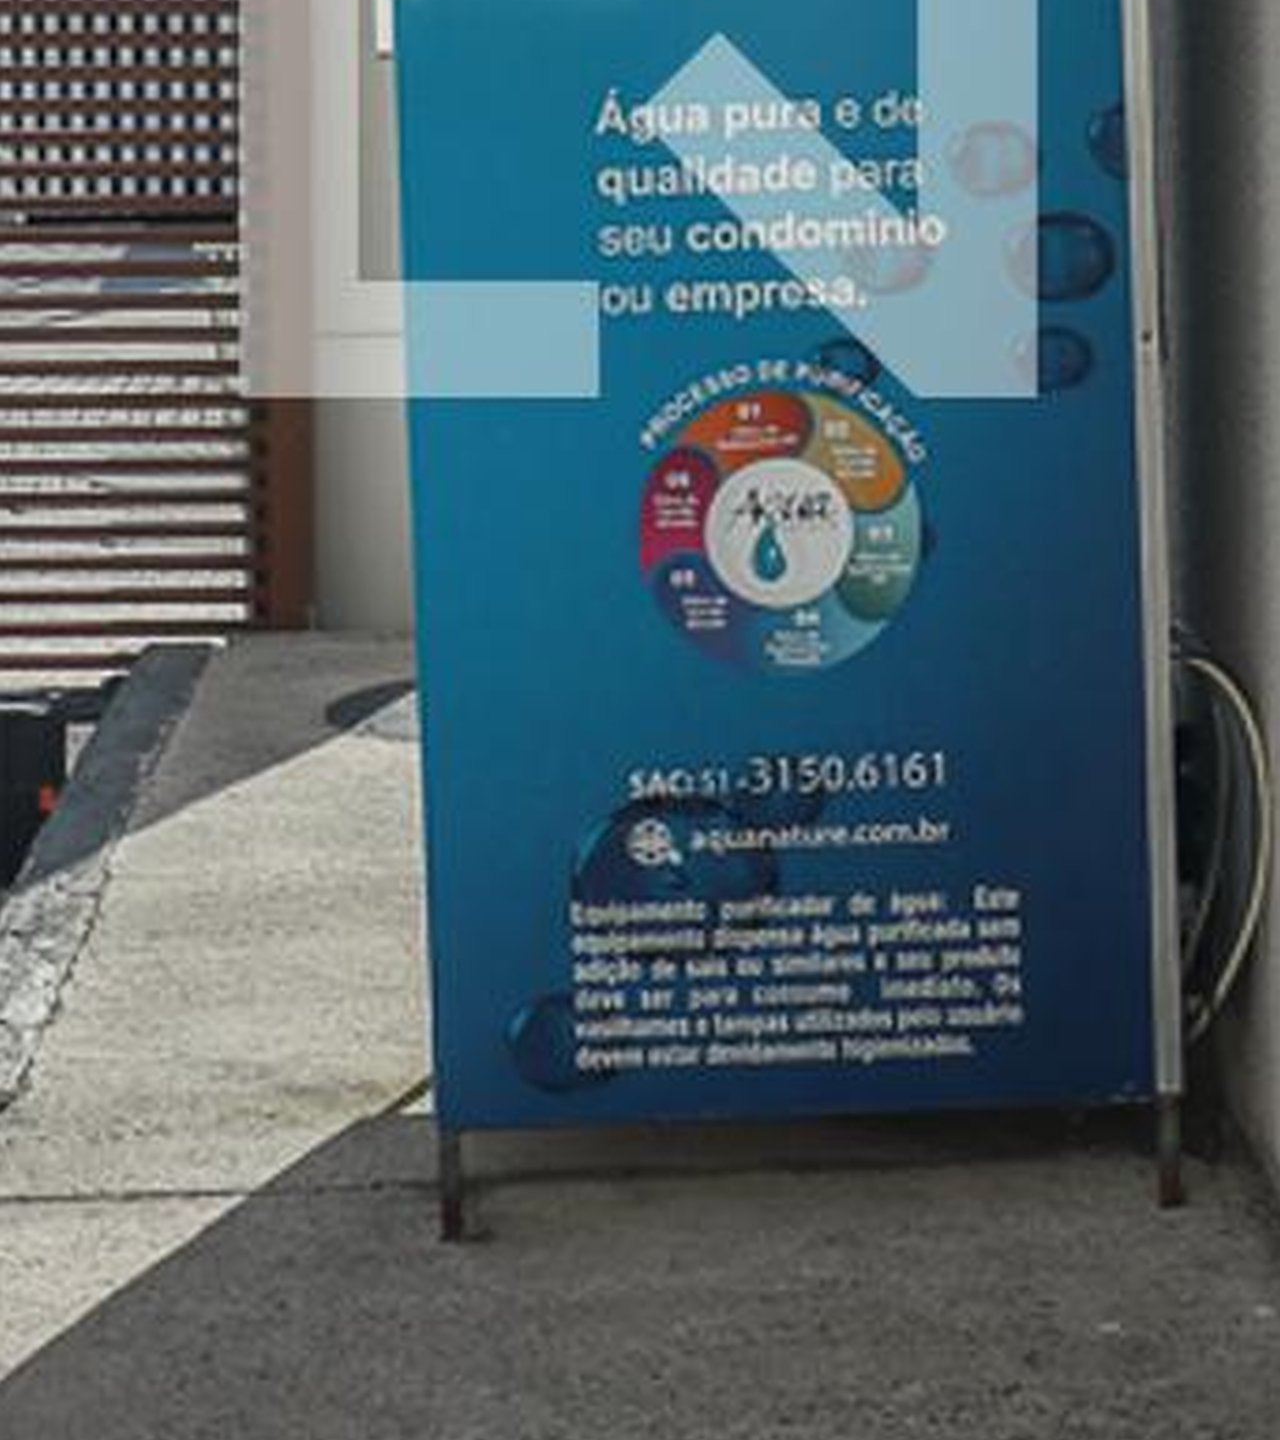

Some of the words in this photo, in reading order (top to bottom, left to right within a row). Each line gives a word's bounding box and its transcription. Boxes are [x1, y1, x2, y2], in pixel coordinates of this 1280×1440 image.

[596, 89, 710, 144] Água
[724, 98, 821, 138] pura
[835, 97, 861, 128] e
[873, 90, 923, 127] de
[596, 153, 818, 204] qualidade
[830, 156, 923, 197] para
[597, 222, 672, 256] seu
[601, 282, 652, 315] ou
[664, 273, 868, 319] empresa.
[690, 817, 951, 856] aquanature.com.br
